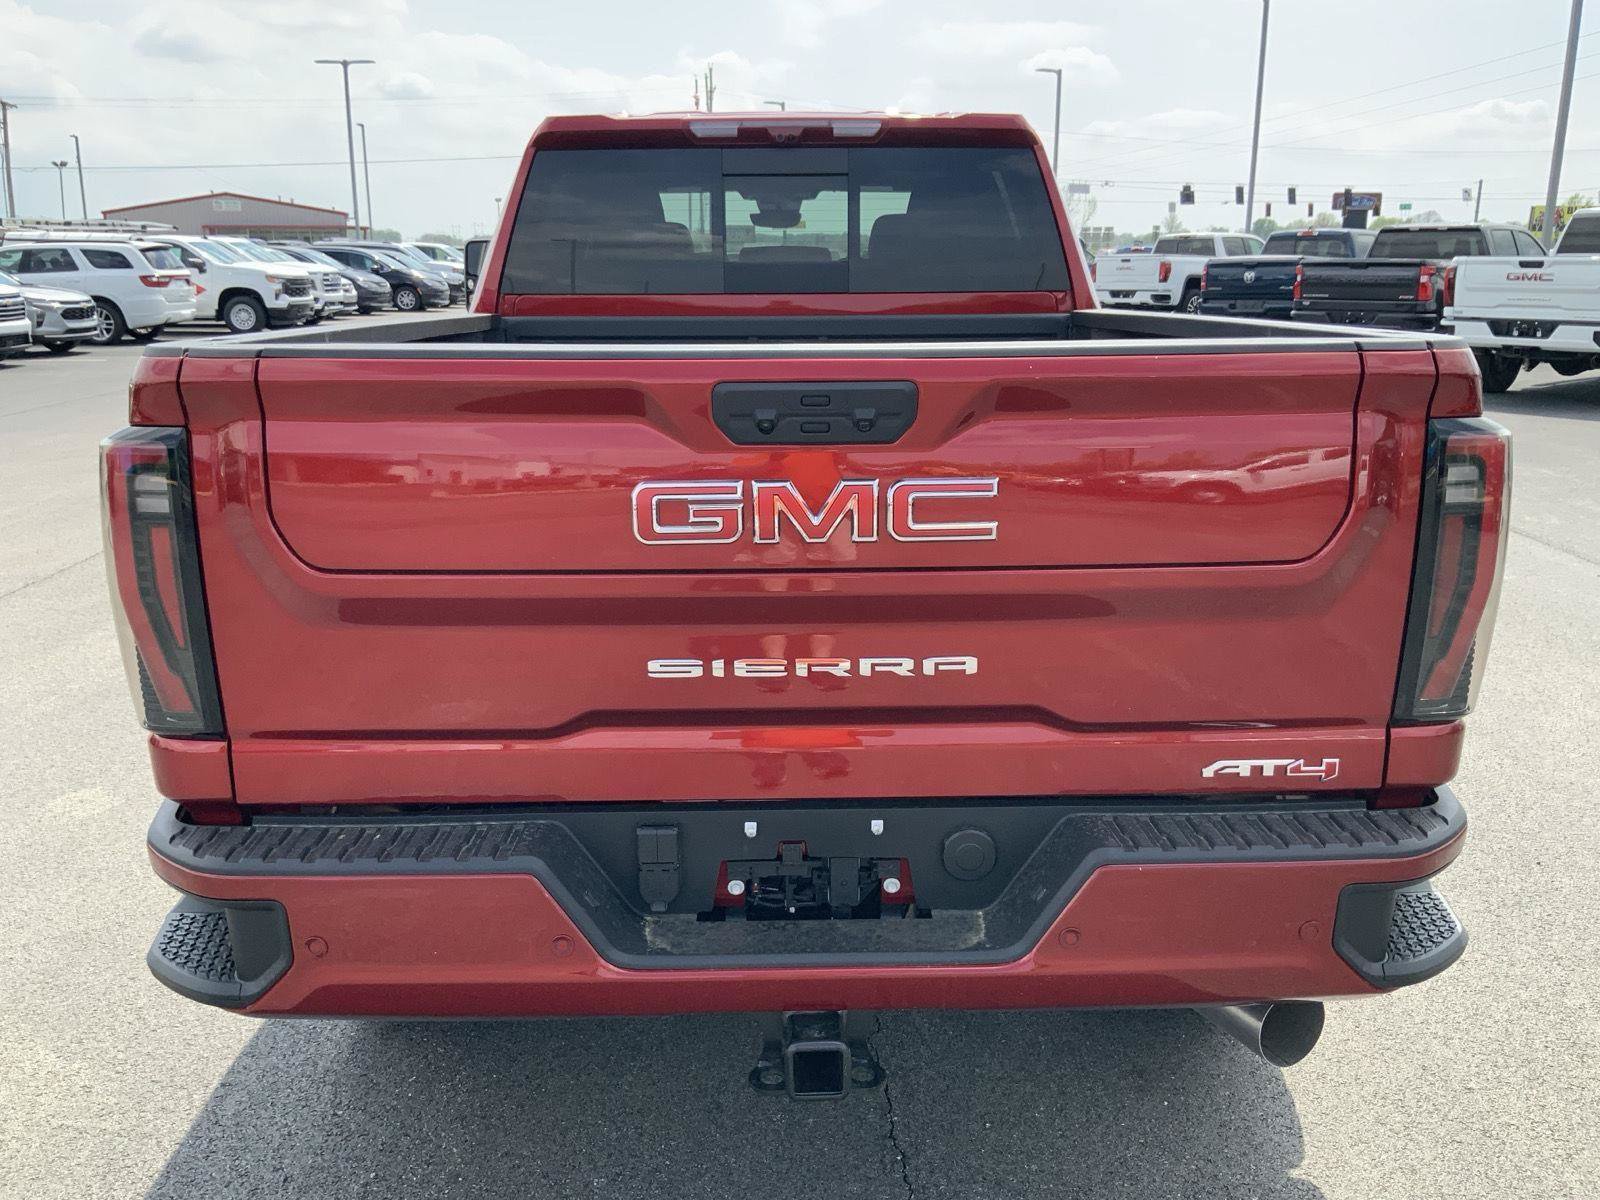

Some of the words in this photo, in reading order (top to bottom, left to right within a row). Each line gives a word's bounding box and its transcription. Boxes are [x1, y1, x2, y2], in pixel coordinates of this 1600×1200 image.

[1506, 272, 1554, 282] GMC
[631, 478, 999, 545] GMC
[647, 655, 979, 678] SIERRA
[1201, 758, 1340, 782] AT4
